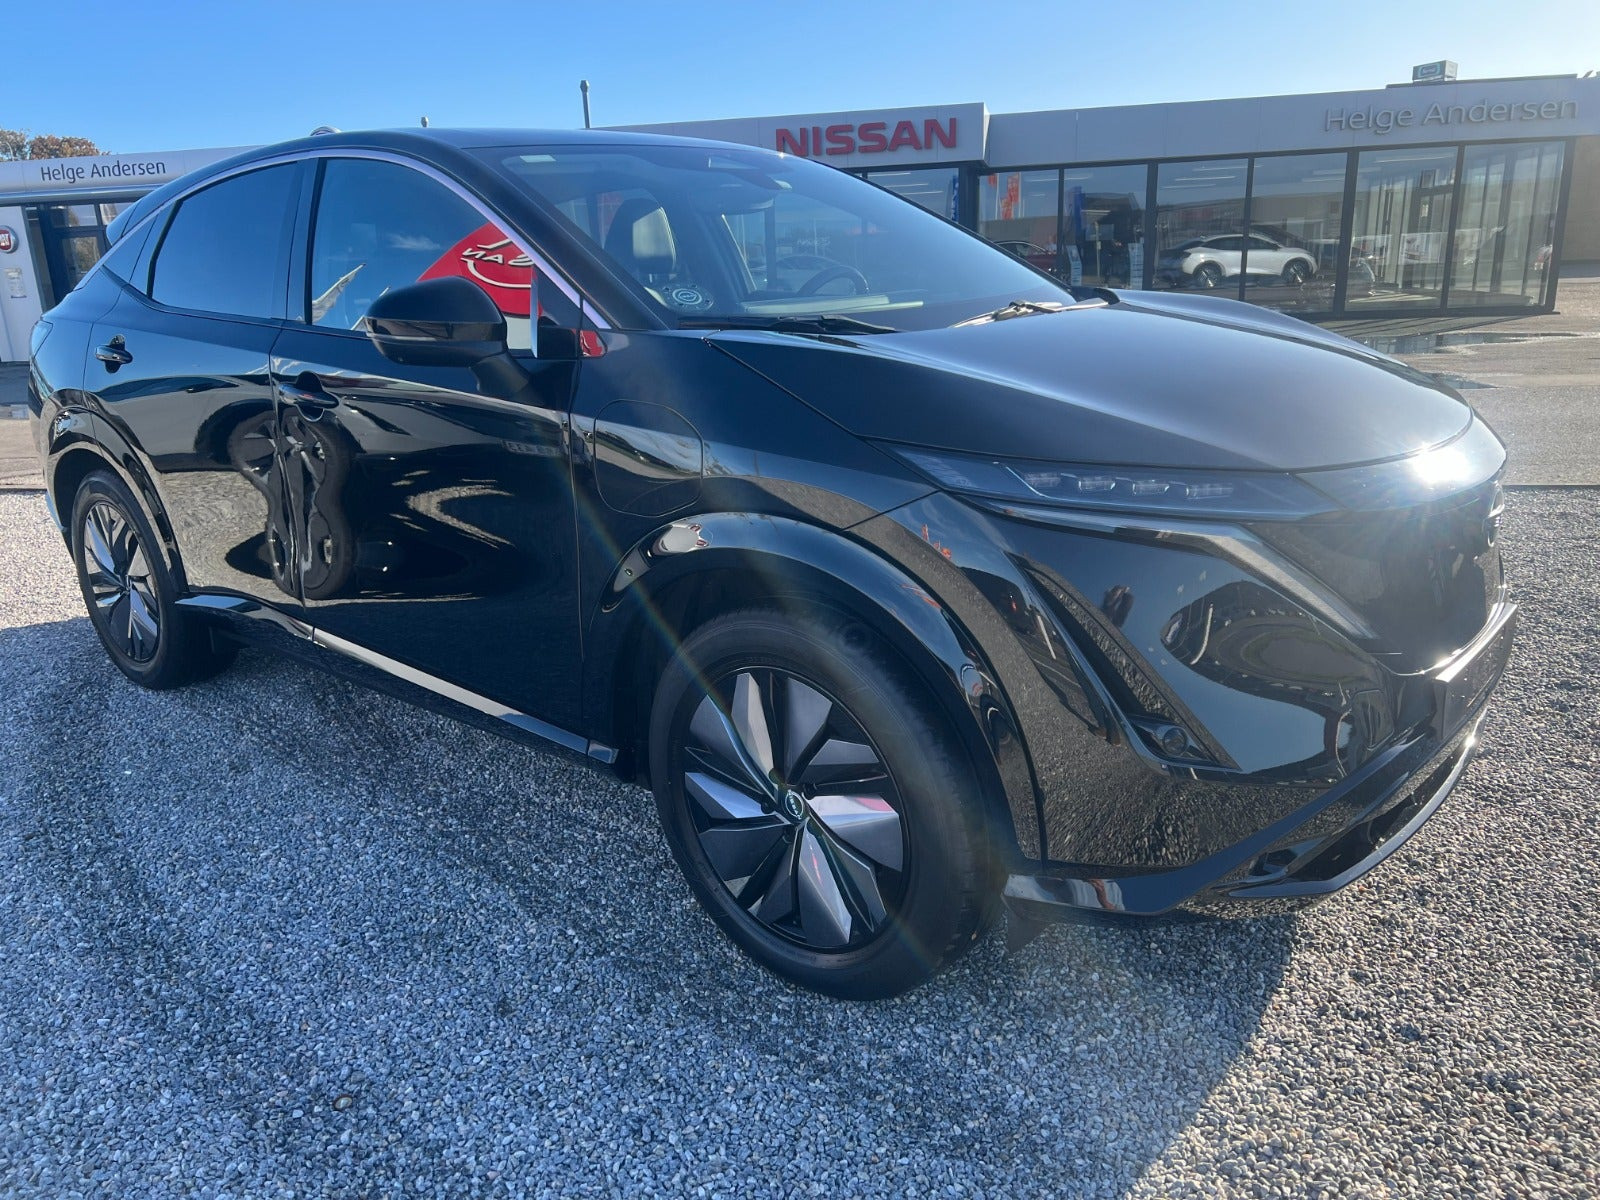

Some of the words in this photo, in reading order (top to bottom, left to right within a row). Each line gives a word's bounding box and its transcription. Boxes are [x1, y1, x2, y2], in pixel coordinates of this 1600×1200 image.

[1324, 105, 1413, 134] Helge
[1421, 98, 1579, 125] Andersen
[775, 117, 957, 158] NISSAN
[40, 163, 85, 184] Helge
[90, 160, 167, 178] Andersen
